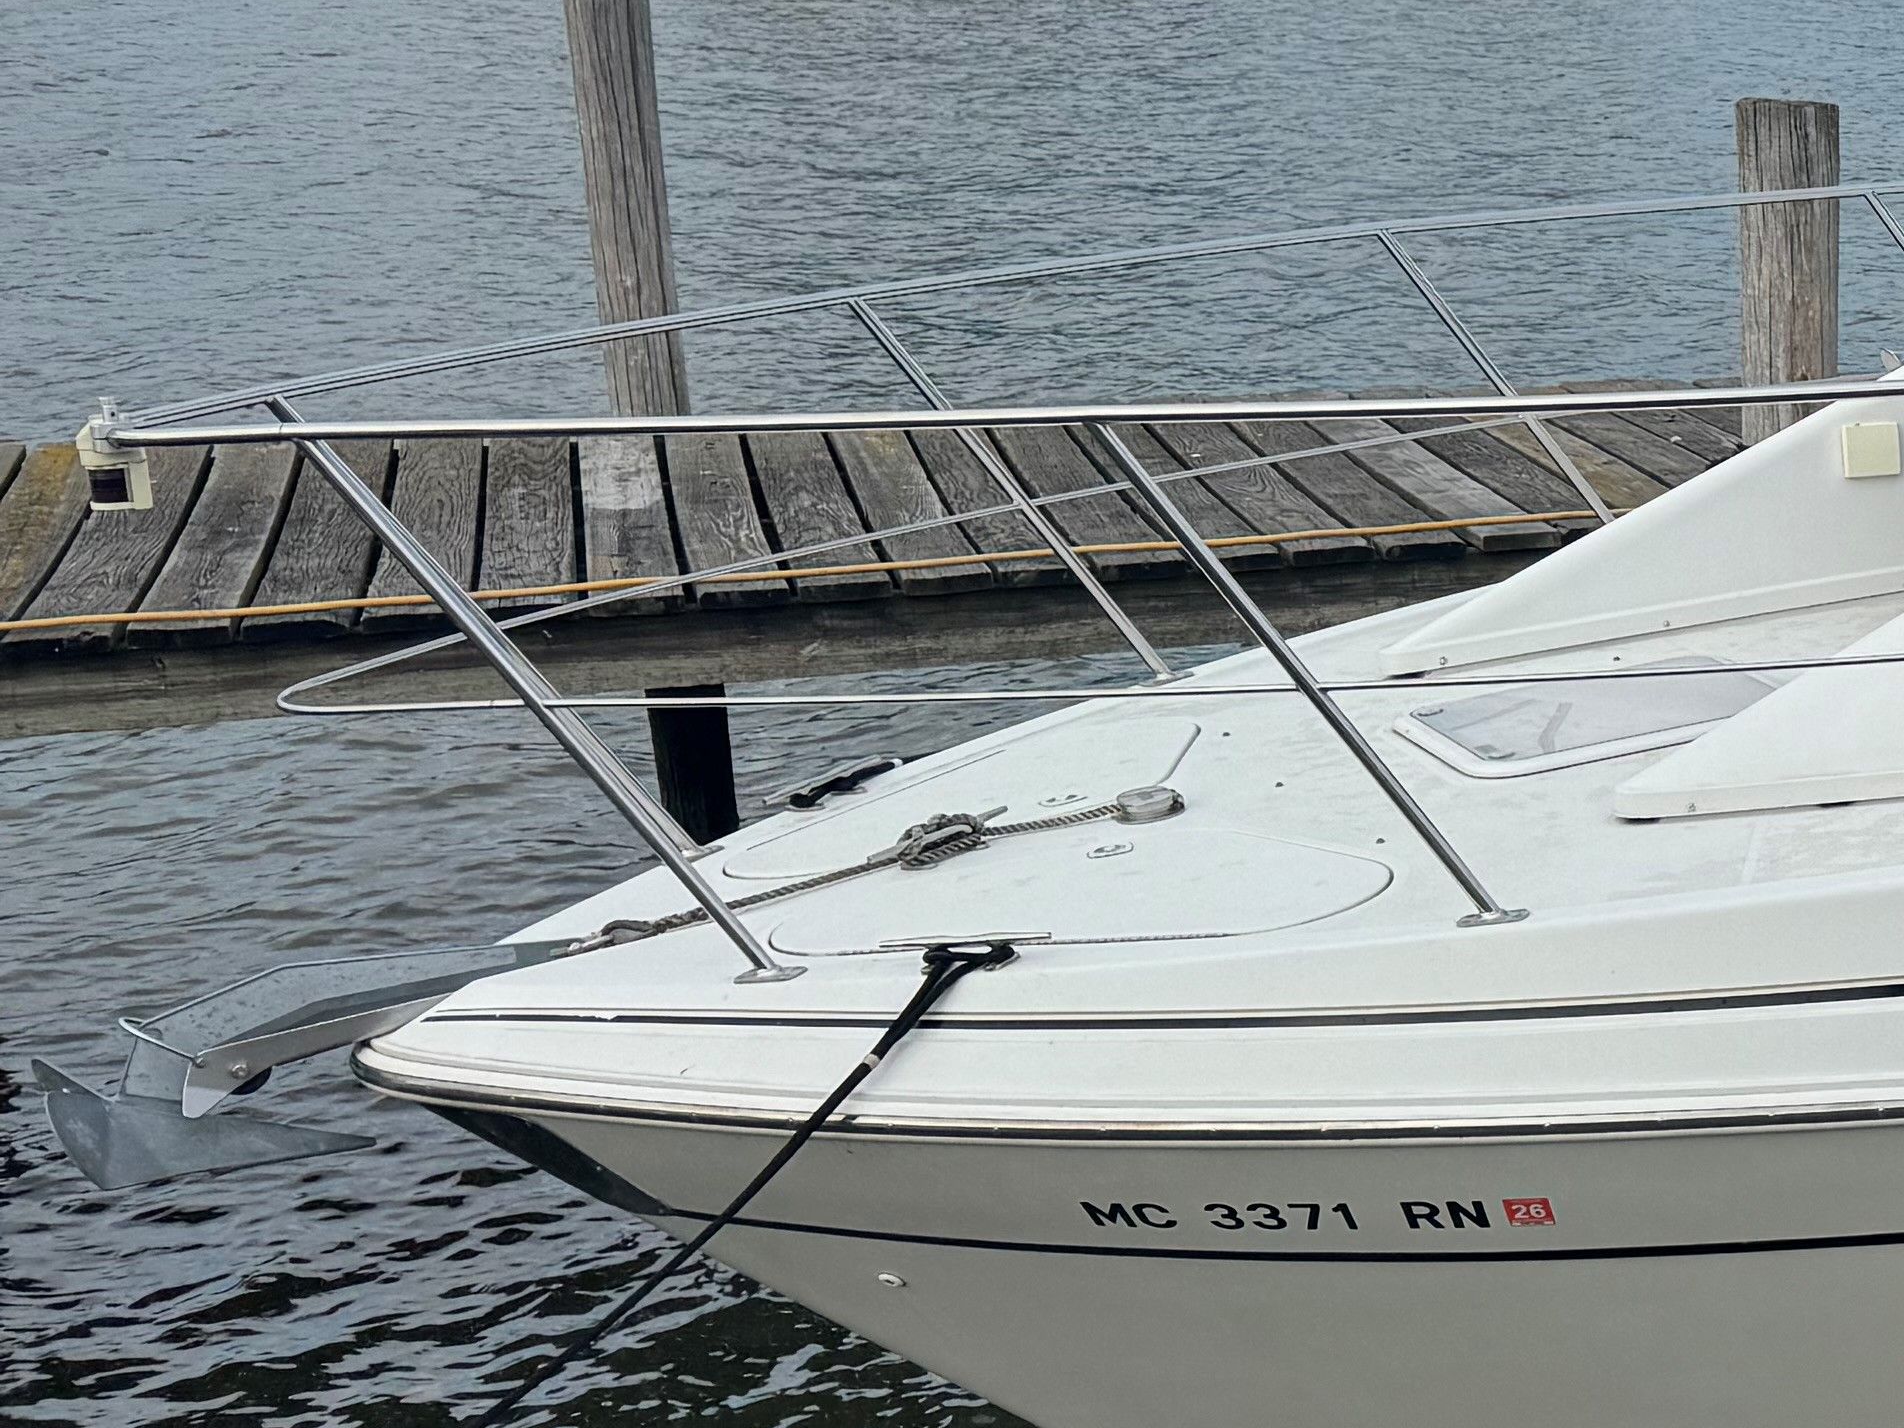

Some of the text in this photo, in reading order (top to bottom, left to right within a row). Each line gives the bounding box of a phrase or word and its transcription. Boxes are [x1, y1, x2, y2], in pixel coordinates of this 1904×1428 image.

[1079, 1200, 1492, 1230] MC 3371 RN
[1511, 1203, 1547, 1219] 26
